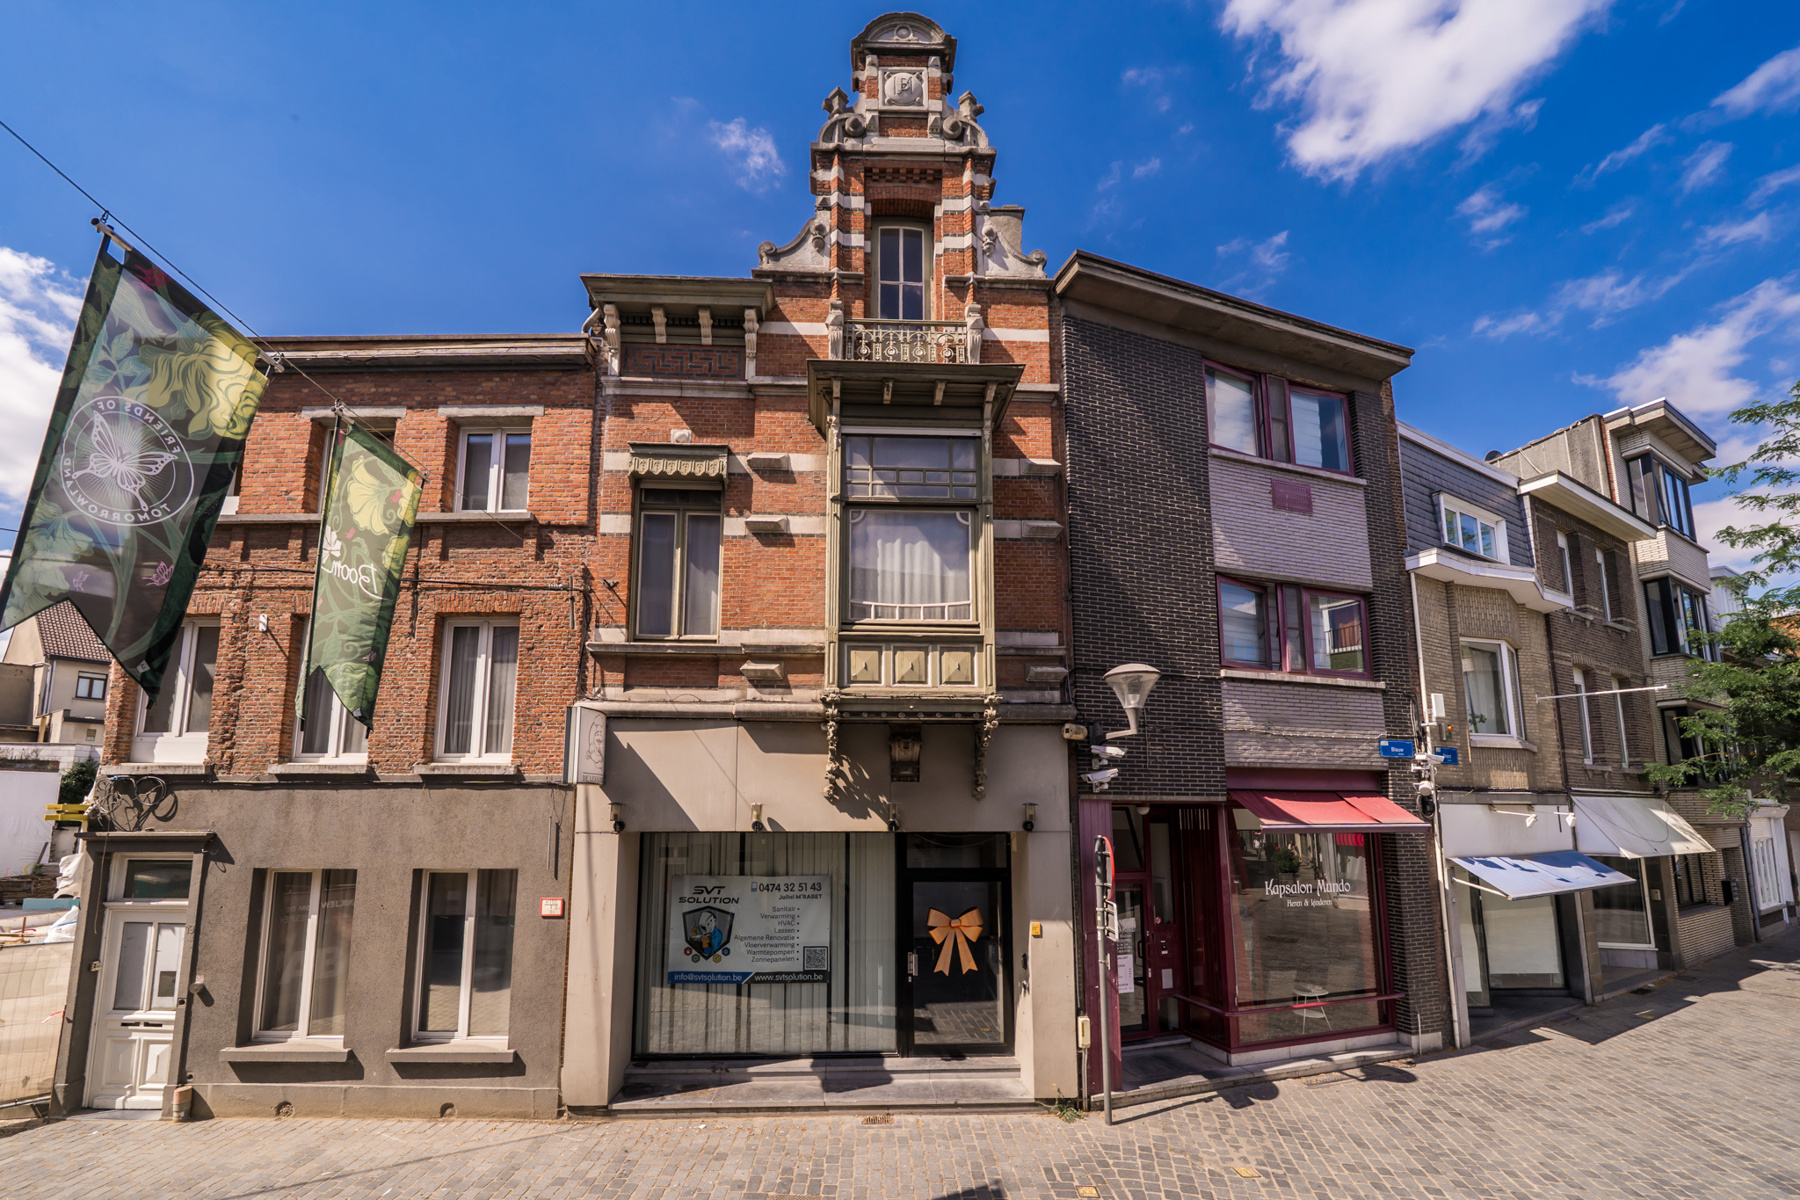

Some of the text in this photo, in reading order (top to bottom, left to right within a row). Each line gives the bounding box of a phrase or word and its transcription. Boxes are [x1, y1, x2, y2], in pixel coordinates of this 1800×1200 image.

[693, 885, 726, 895] SVT
[758, 882, 822, 893] 0474 32 51 43
[1264, 878, 1351, 898] Kapsalon Mundo
[678, 896, 740, 905] SOLUTION
[772, 905, 796, 913] Sanitair
[733, 934, 796, 943] Algemene Renovatie
[744, 942, 796, 950] Vloerverwarming
[746, 949, 795, 957] Warmtepompen
[751, 956, 795, 964] Zonnepanelen
[674, 972, 743, 981] info@svtsolution.be
[754, 972, 824, 982] www.svtsolution.be
